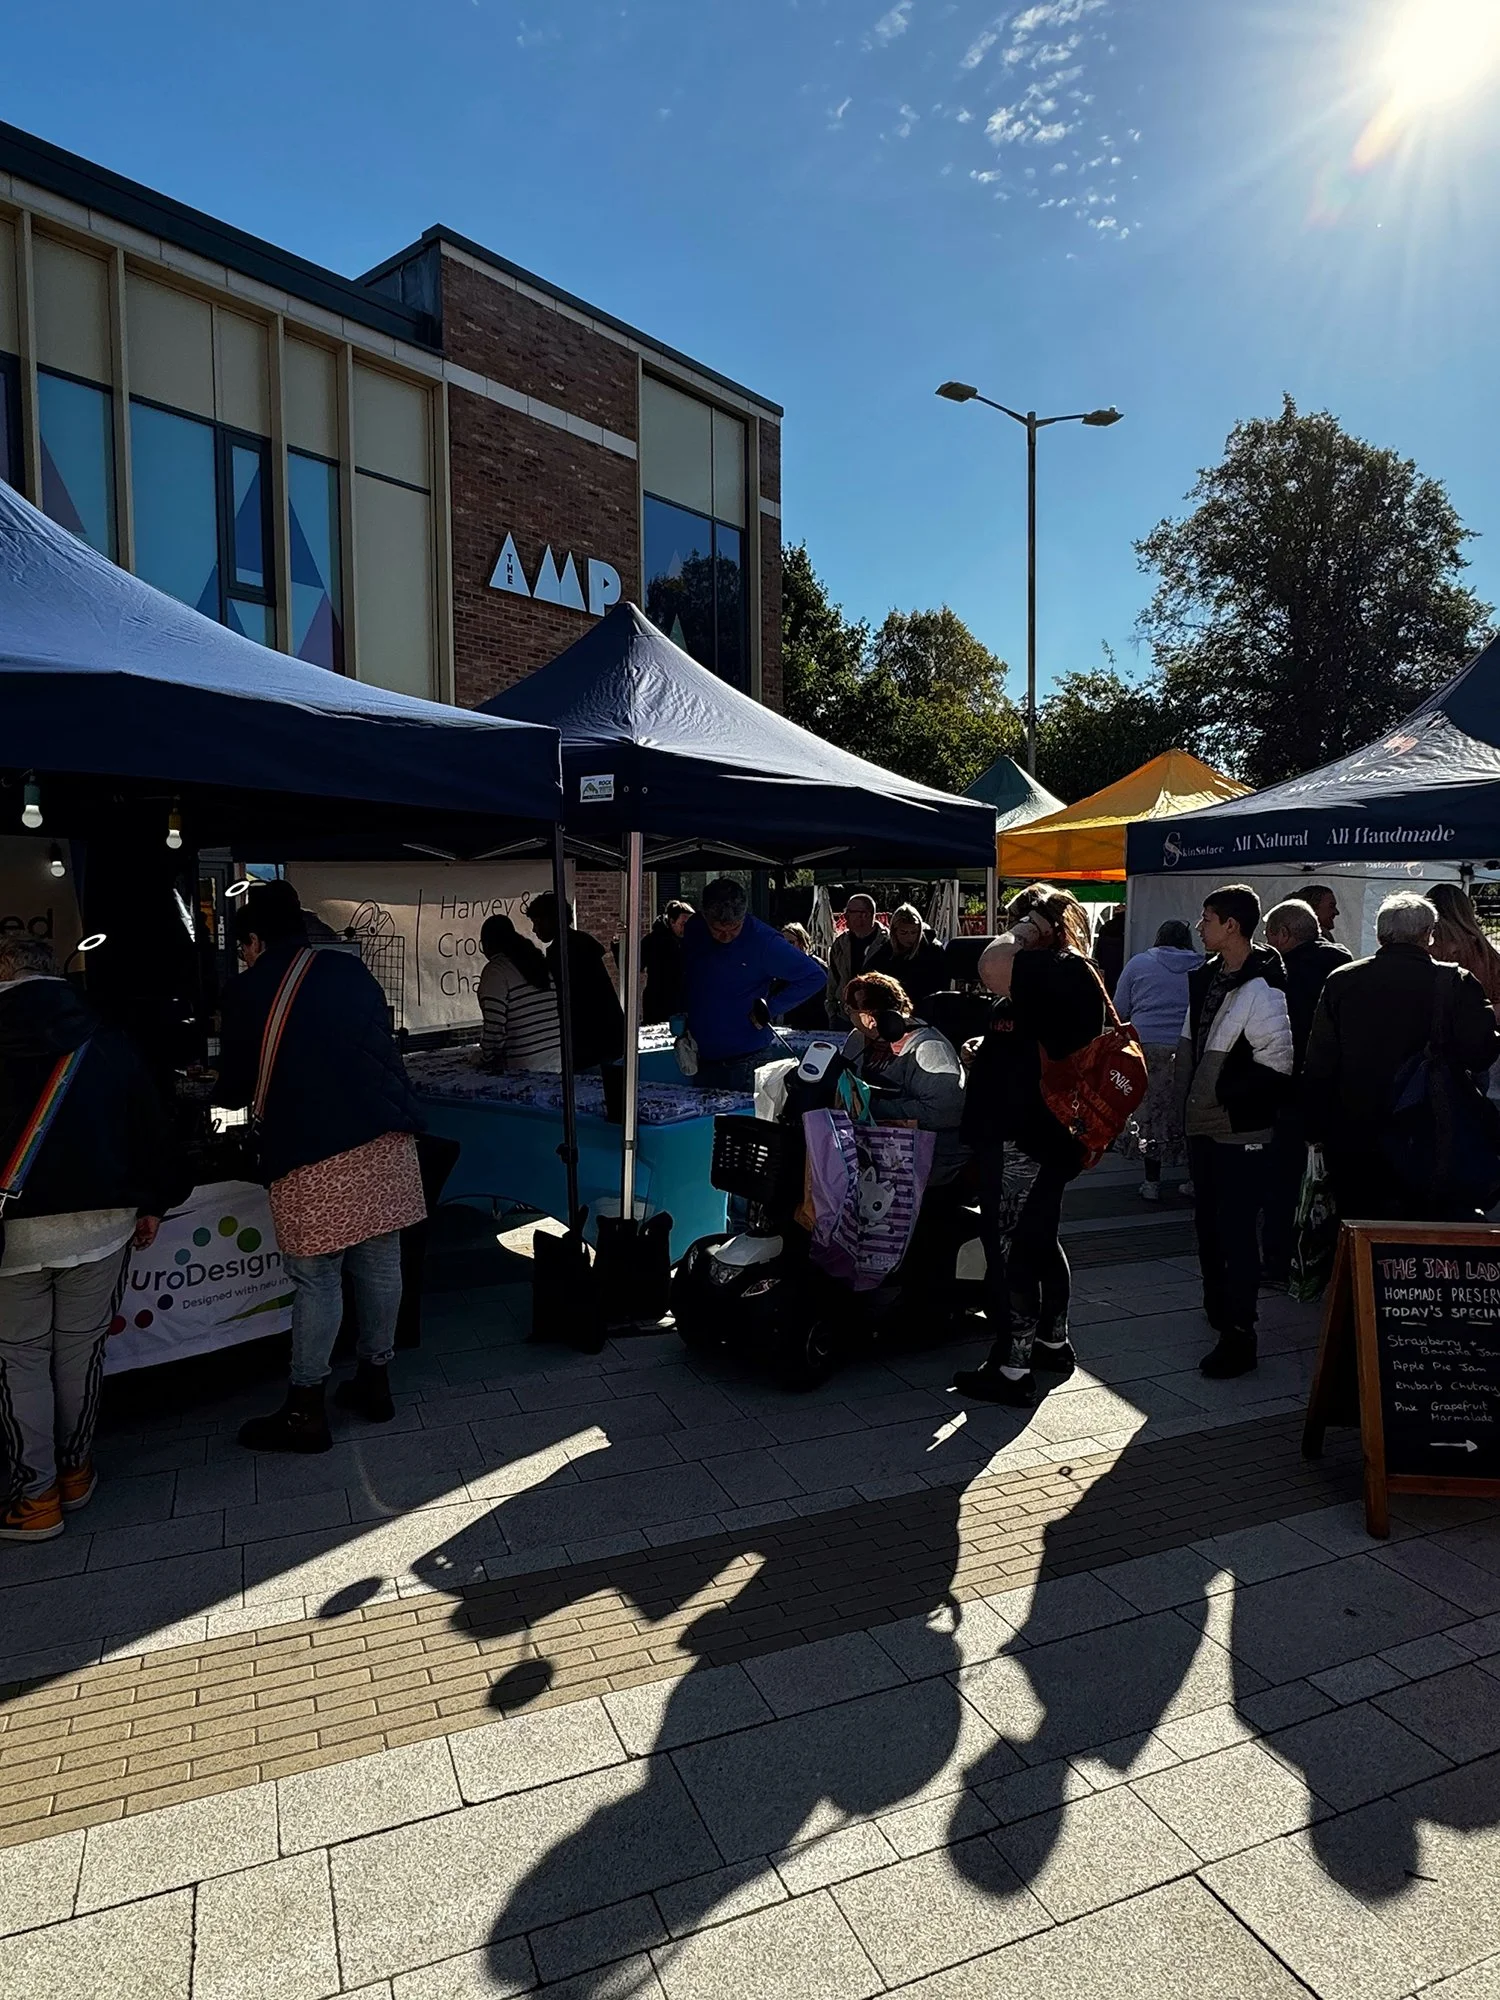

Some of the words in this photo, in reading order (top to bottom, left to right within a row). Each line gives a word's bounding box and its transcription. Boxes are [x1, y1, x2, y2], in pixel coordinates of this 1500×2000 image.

[489, 531, 622, 617] AMP
[506, 553, 514, 585] THE
[1231, 834, 1251, 852] All
[1256, 829, 1308, 849] Natural
[1327, 827, 1349, 845] All
[1355, 824, 1456, 844] Handmade
[441, 895, 515, 919] Harvey
[1110, 1069, 1133, 1096] Nike
[1378, 1257, 1417, 1280] THE
[1423, 1257, 1459, 1280] JAM
[183, 1289, 232, 1309] Designed
[235, 1284, 258, 1299] with
[1384, 1287, 1443, 1302] HOMEMADE
[1382, 1305, 1443, 1318] TODAY'S
[1387, 1334, 1462, 1350] Strawberry
[1421, 1346, 1472, 1356] Banana
[1393, 1360, 1424, 1374] Apple
[1433, 1361, 1452, 1371] Pie
[1458, 1363, 1487, 1372] Jam
[1451, 1381, 1500, 1397] Chutney
[1394, 1401, 1419, 1412] Pink
[1430, 1400, 1488, 1412] Grapefruit
[1431, 1412, 1492, 1423] Marmalade
